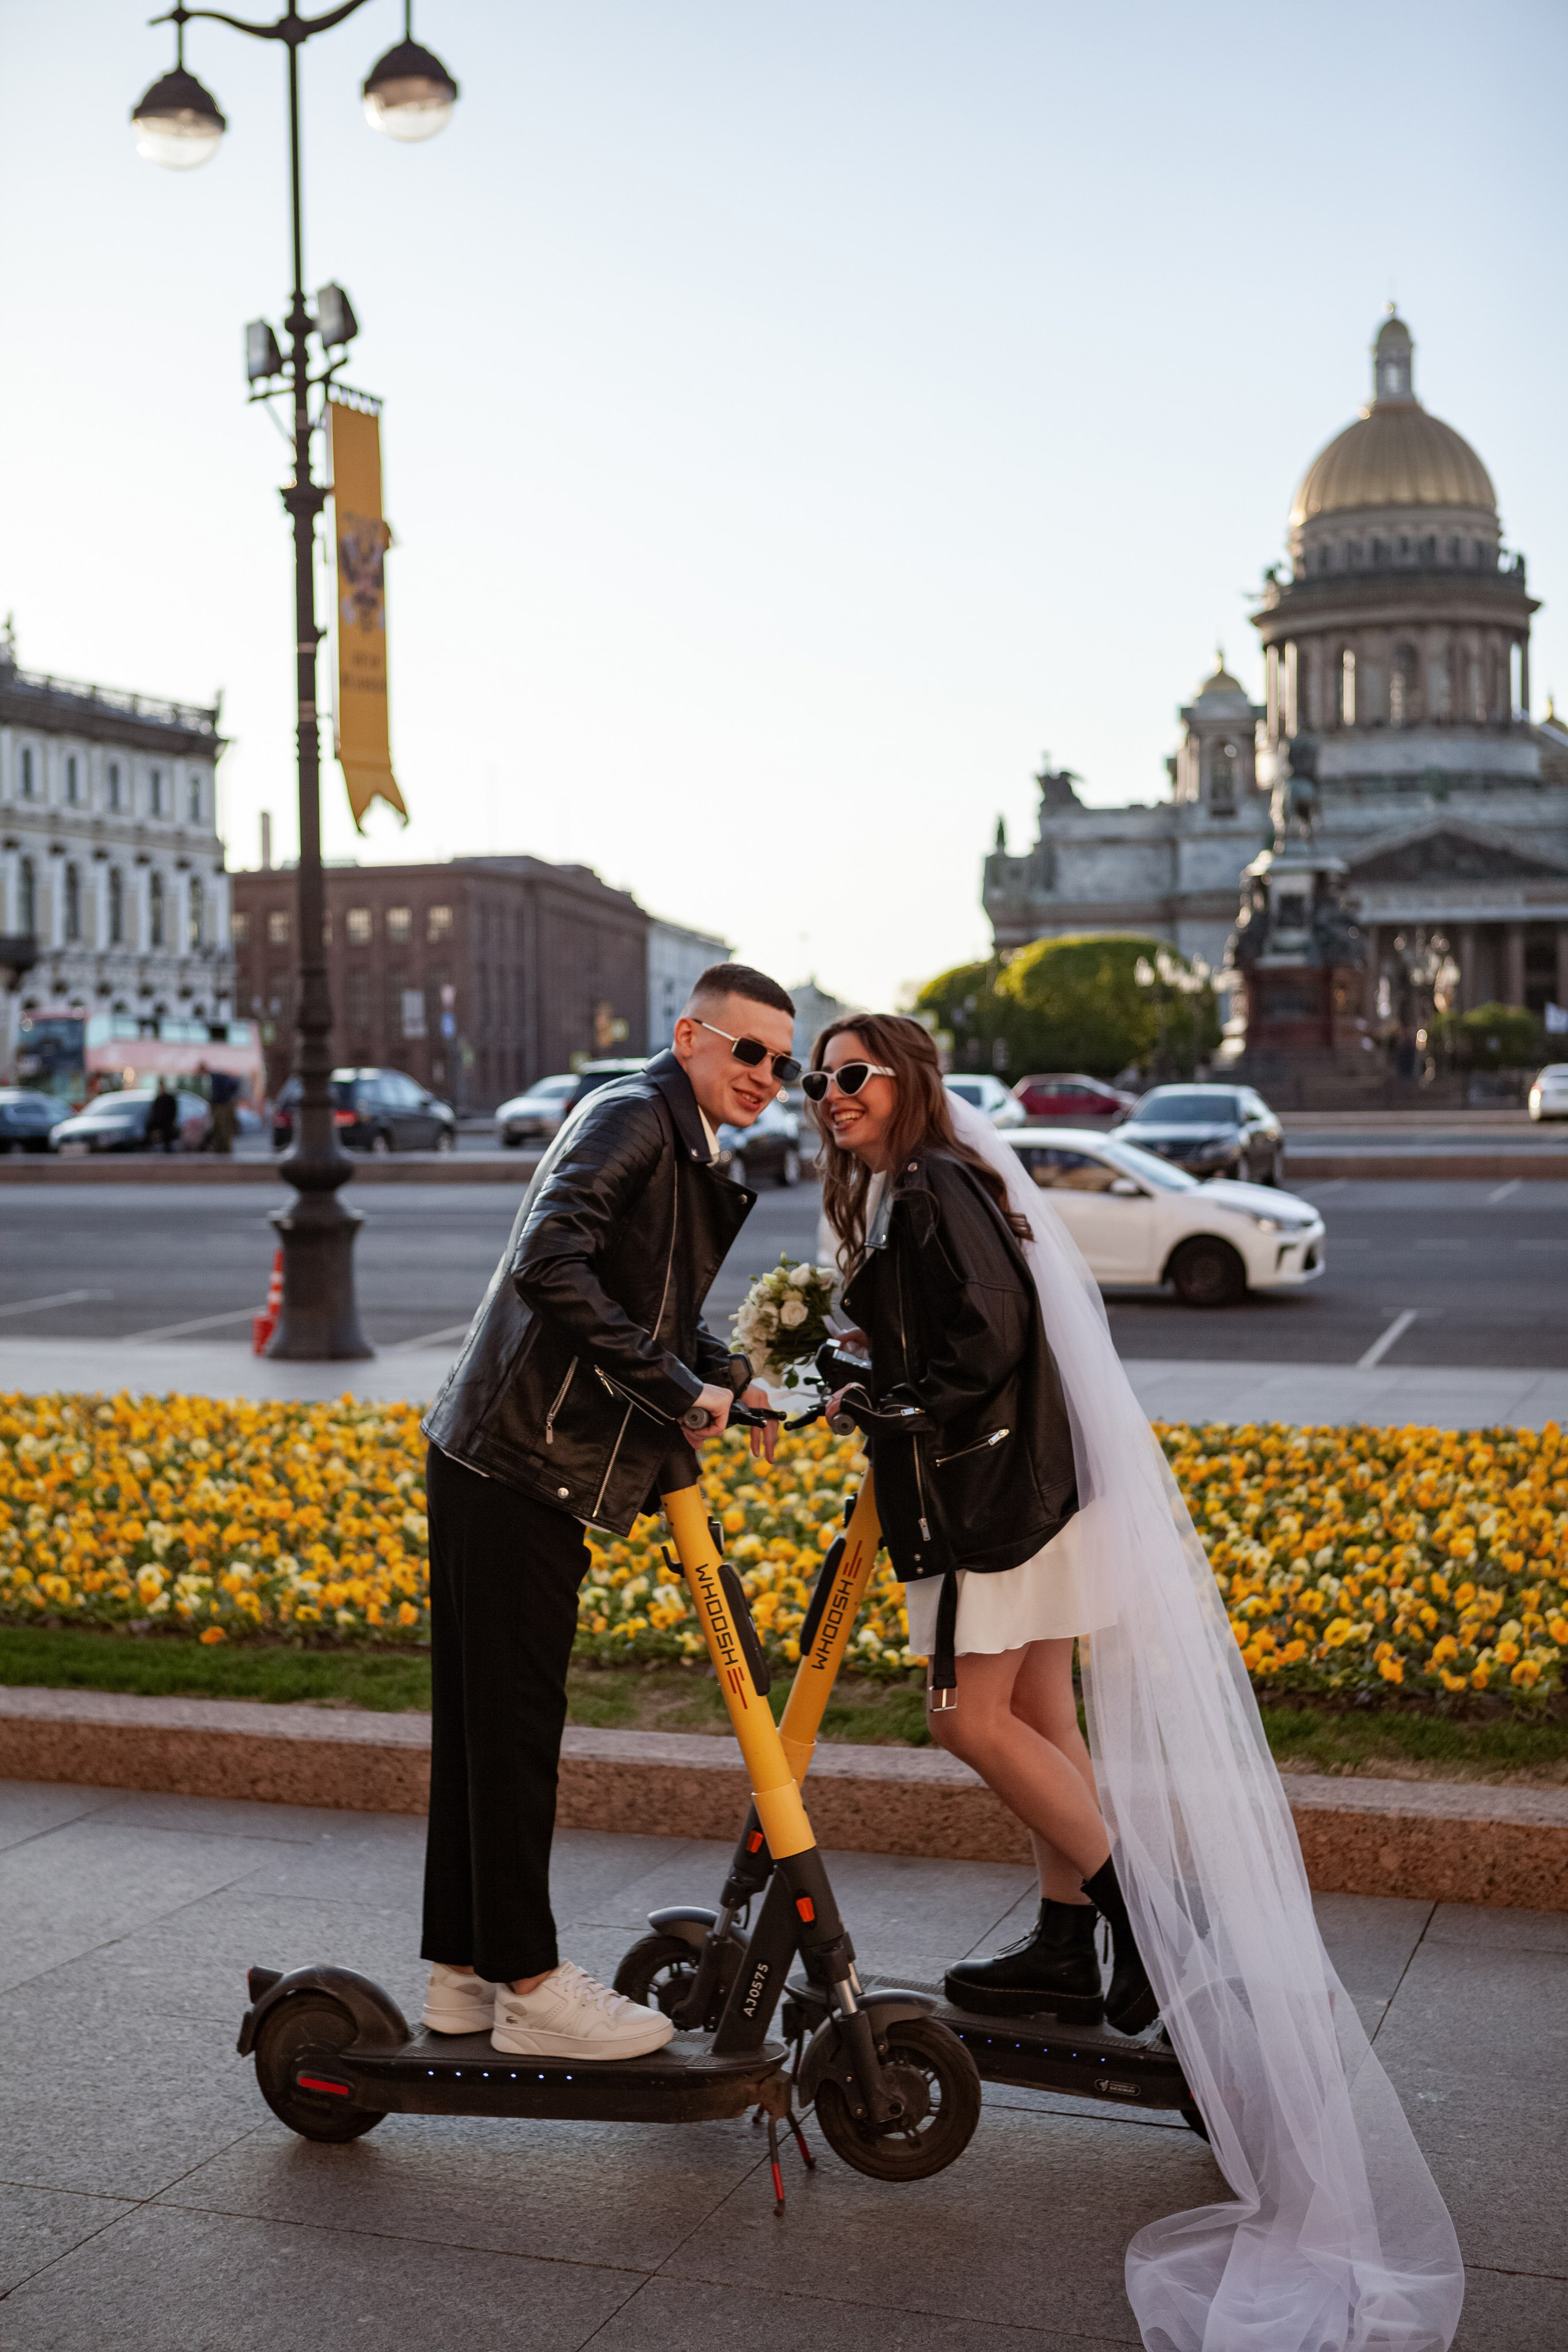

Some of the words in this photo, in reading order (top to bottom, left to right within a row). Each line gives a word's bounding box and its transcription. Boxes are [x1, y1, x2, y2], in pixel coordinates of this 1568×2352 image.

[695, 1563, 739, 1665] WHOOSH
[811, 1579, 854, 1670] WHOOSH
[743, 1963, 769, 2017] AJ0575
